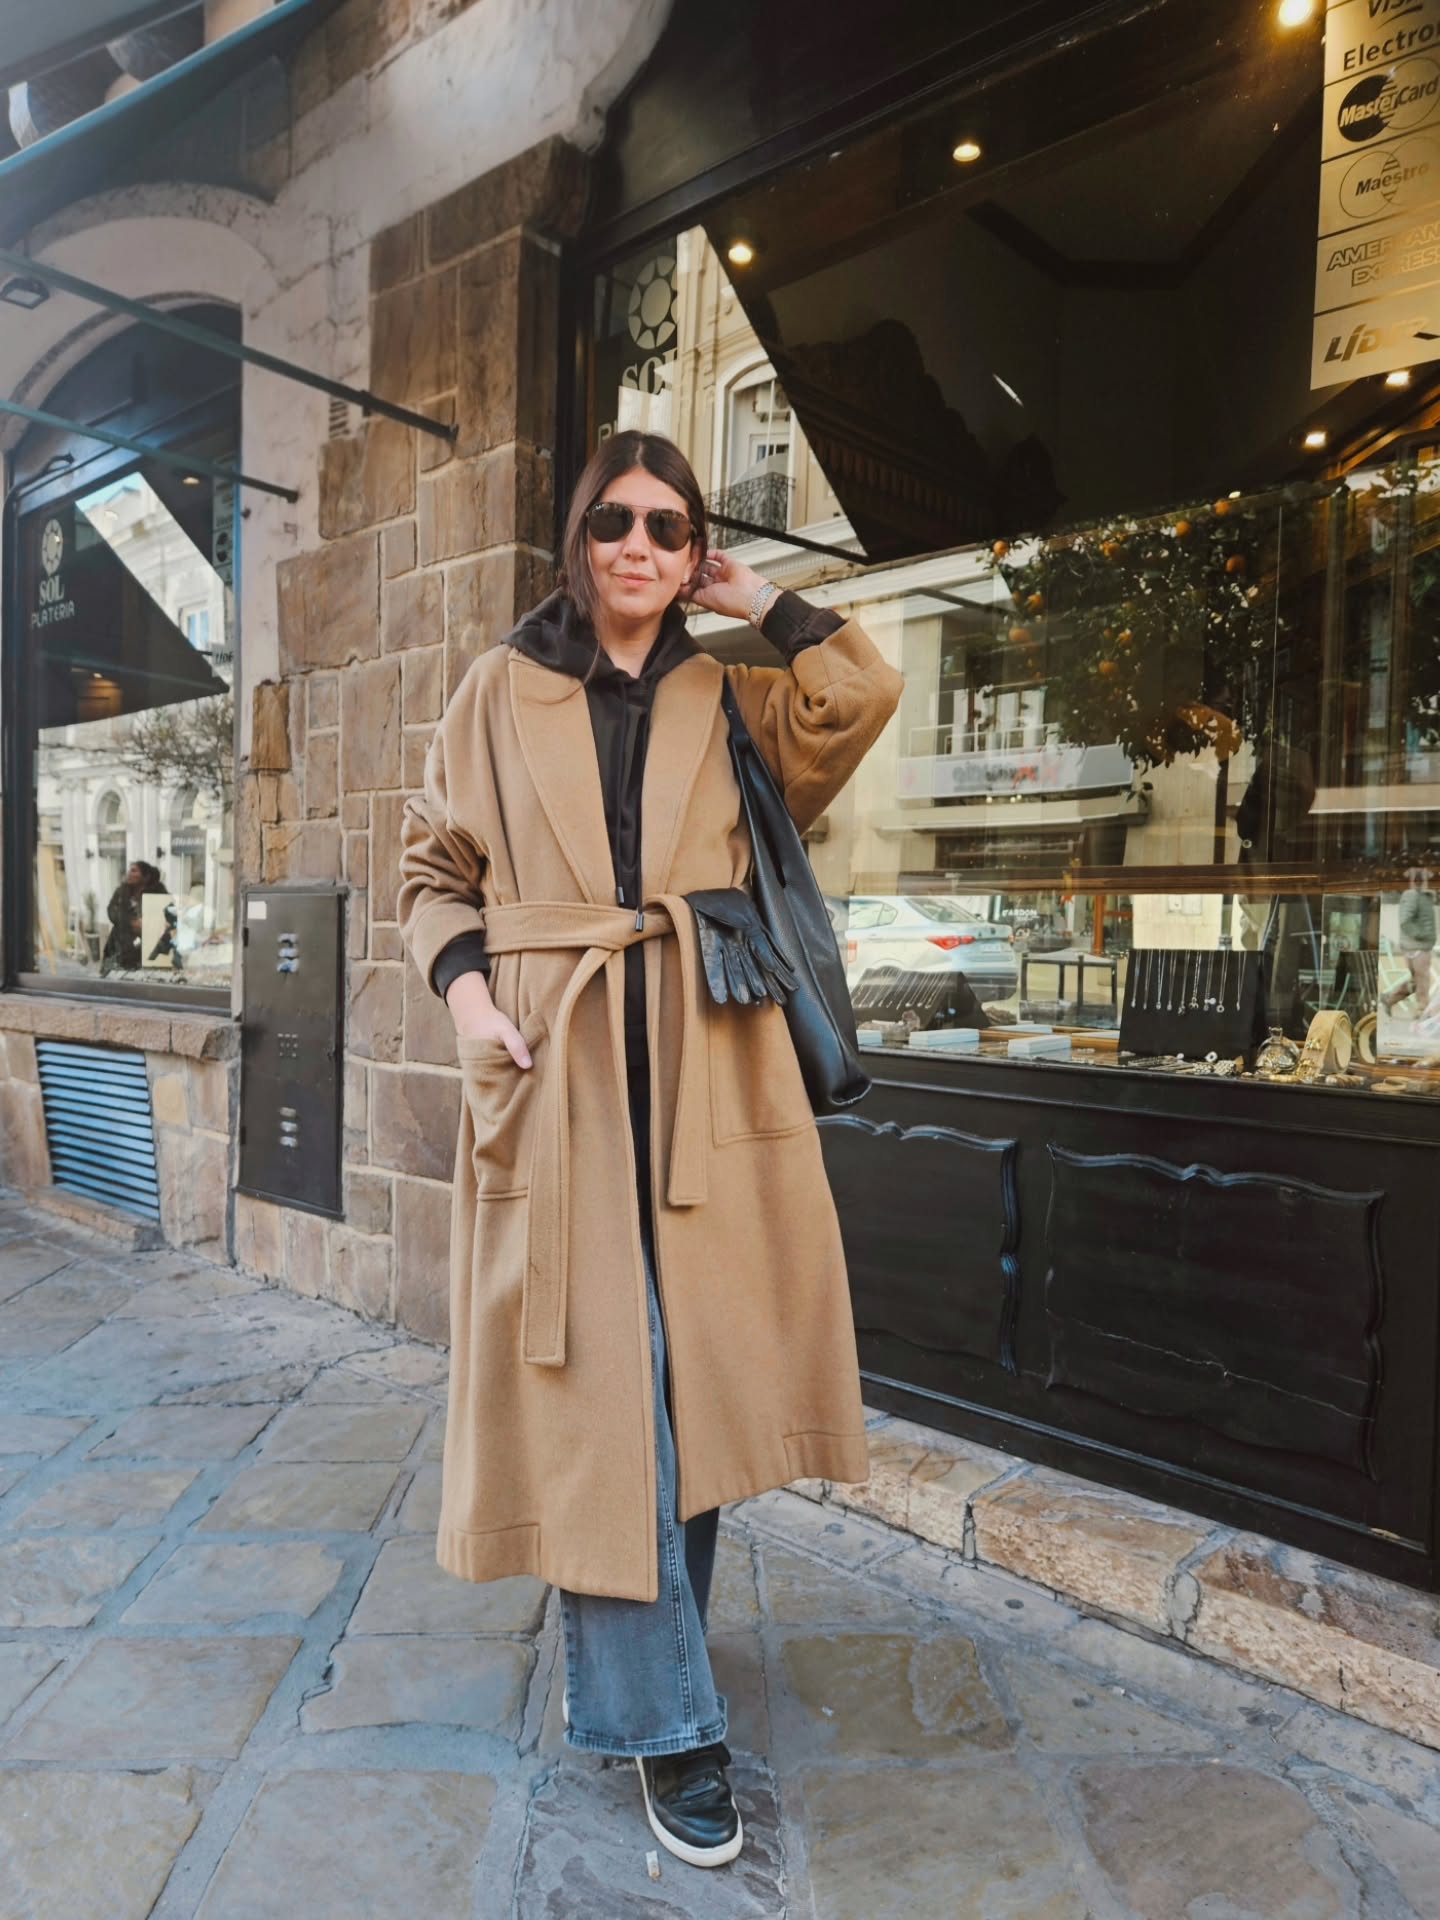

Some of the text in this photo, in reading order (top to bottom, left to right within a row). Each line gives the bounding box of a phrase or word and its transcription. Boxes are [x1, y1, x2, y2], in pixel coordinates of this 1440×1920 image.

[1343, 21, 1440, 71] Electro
[1339, 76, 1439, 128] MasterCard
[1355, 162, 1430, 196] Maestro
[39, 575, 65, 606] SOL
